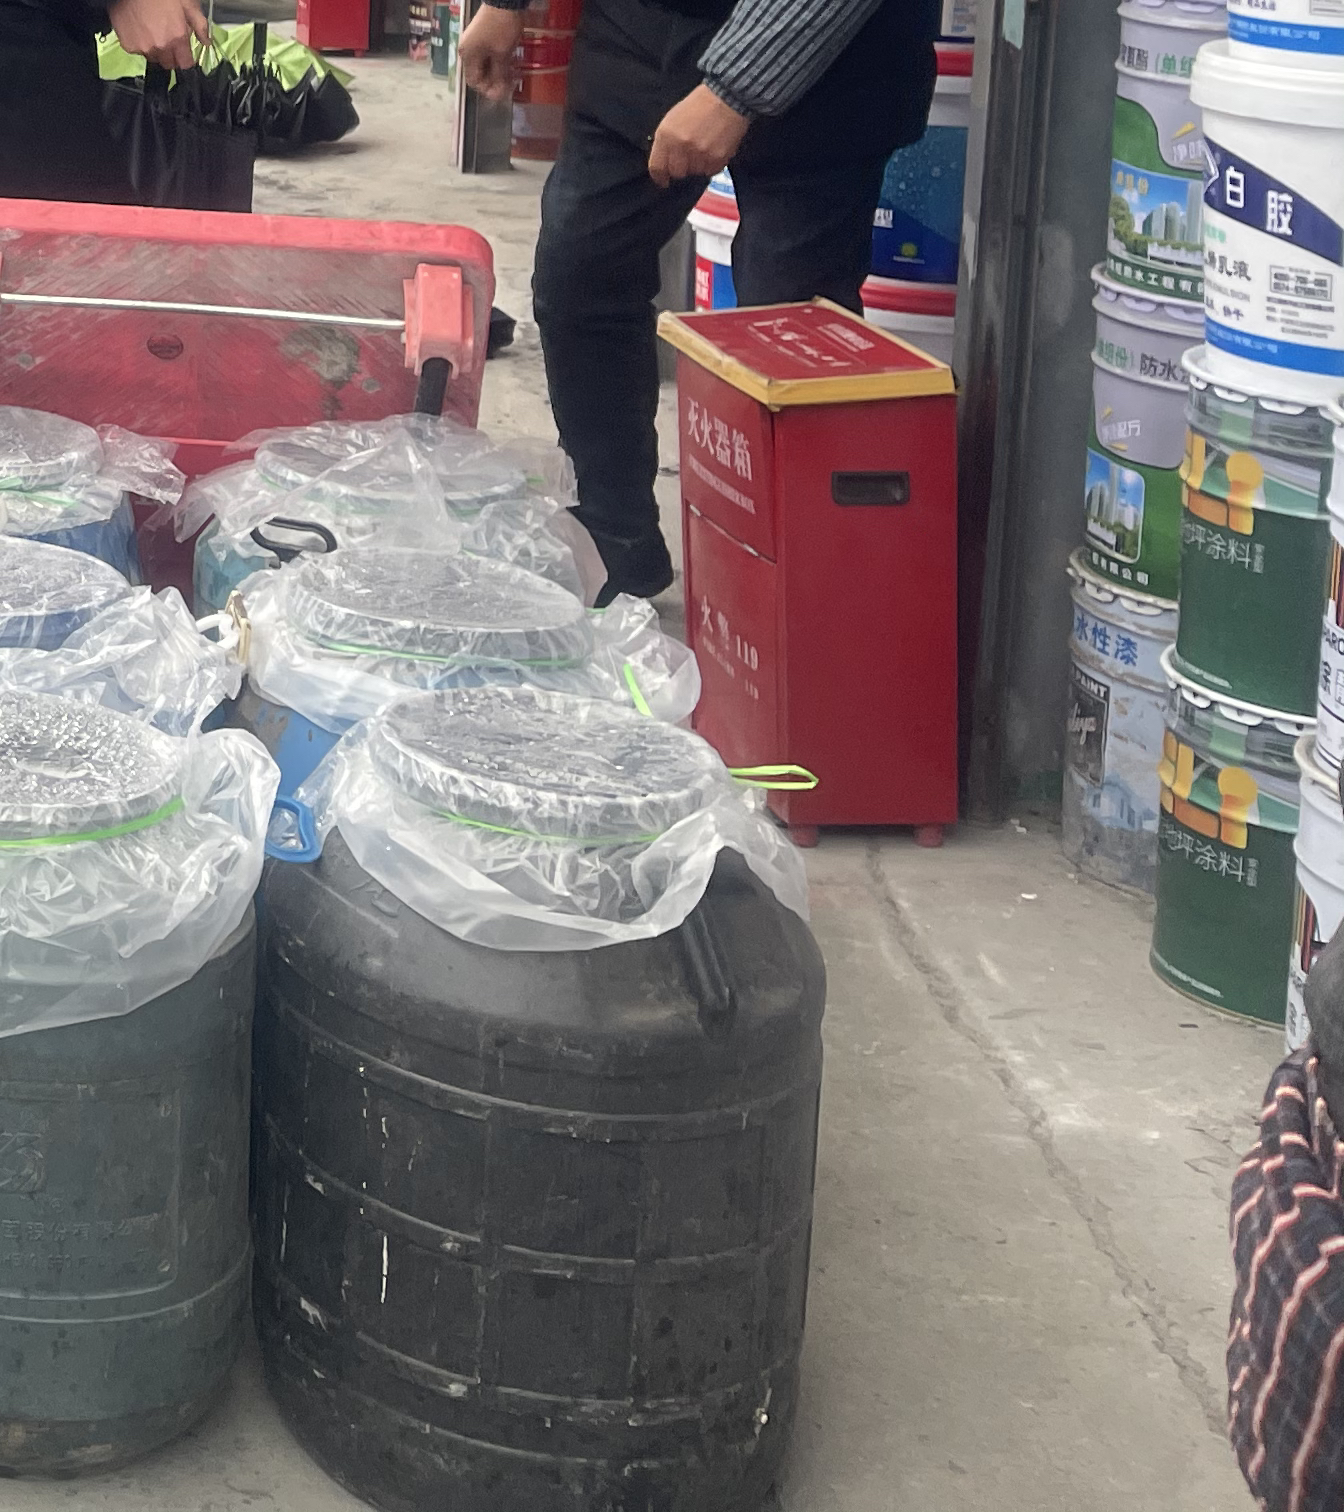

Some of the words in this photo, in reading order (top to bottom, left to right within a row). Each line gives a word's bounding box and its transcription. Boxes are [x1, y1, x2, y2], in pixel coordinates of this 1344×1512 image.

[687, 396, 753, 482] 灭火器箱
[736, 634, 760, 672] 119
[1075, 613, 1139, 667] 水性漆
